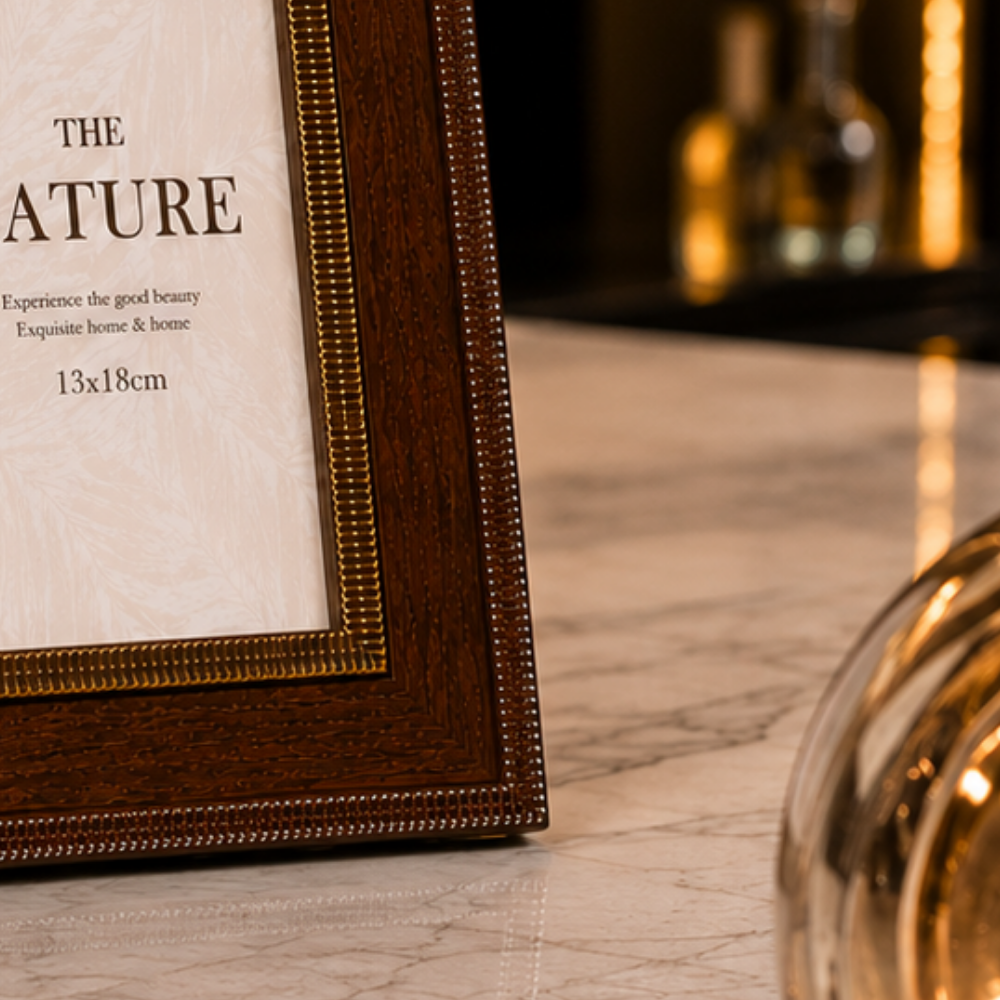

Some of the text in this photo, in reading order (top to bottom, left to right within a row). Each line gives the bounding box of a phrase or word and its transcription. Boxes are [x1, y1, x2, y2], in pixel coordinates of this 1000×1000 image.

[53, 116, 125, 148] THE
[1, 288, 201, 313] Experience the good beauty
[16, 315, 191, 341] Exquisite home & home
[56, 366, 168, 395] 13x18cm
